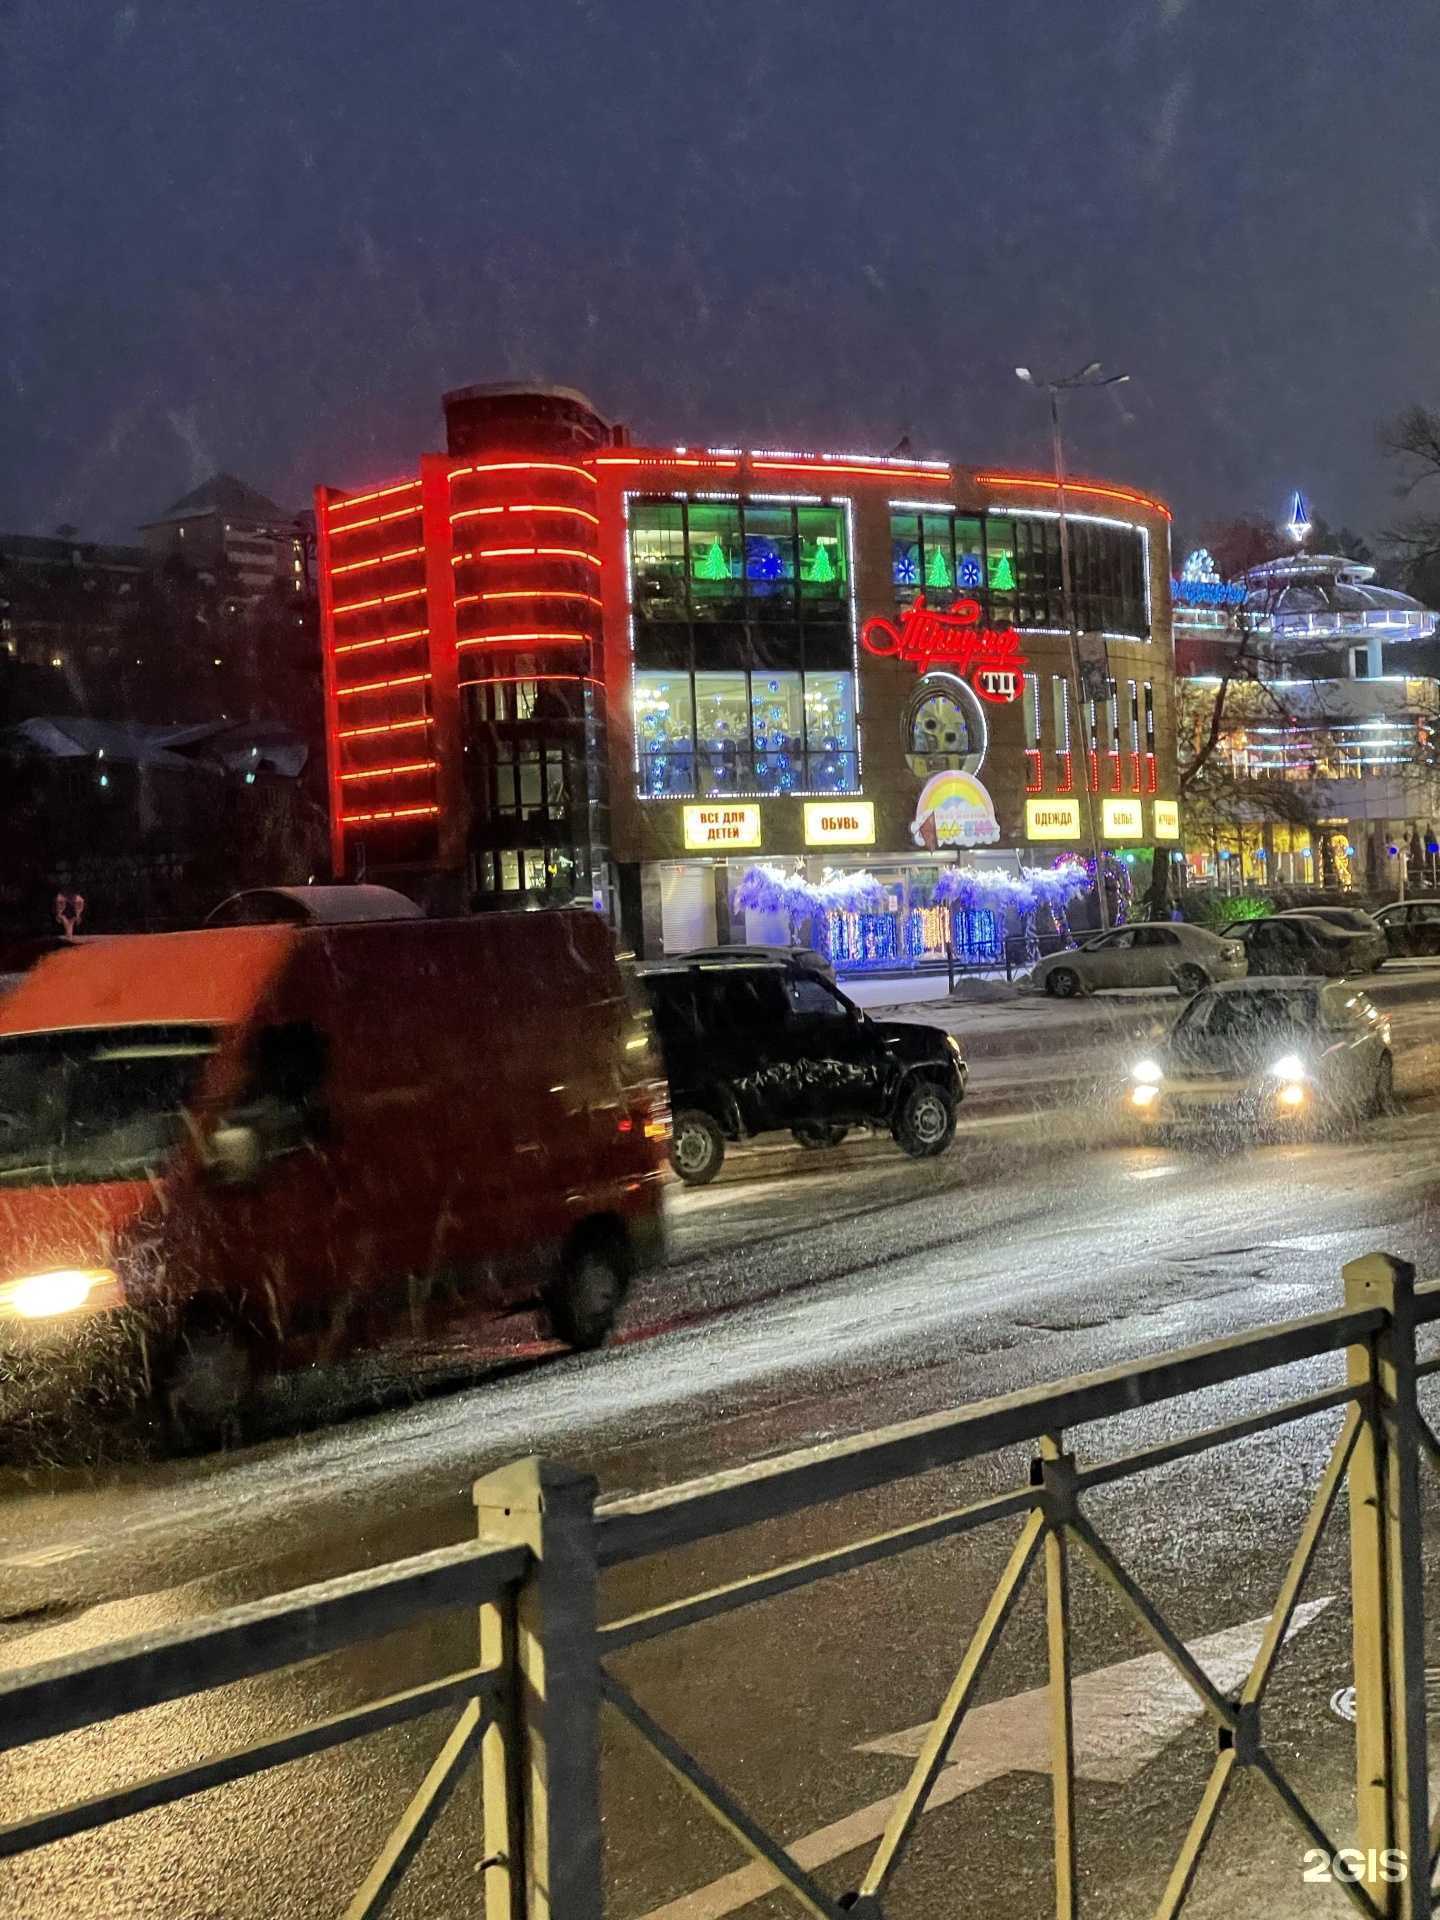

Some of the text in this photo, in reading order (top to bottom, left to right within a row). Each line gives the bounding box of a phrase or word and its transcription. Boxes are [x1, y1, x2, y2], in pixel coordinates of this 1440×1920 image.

[982, 671, 1016, 702] ТЦ
[700, 811, 745, 824] ВСЕ ДЛЯ
[821, 816, 859, 831] ОБУВЬ
[1034, 811, 1072, 827] ОДЕЖДА
[707, 827, 740, 841] ДЕТЕЙ
